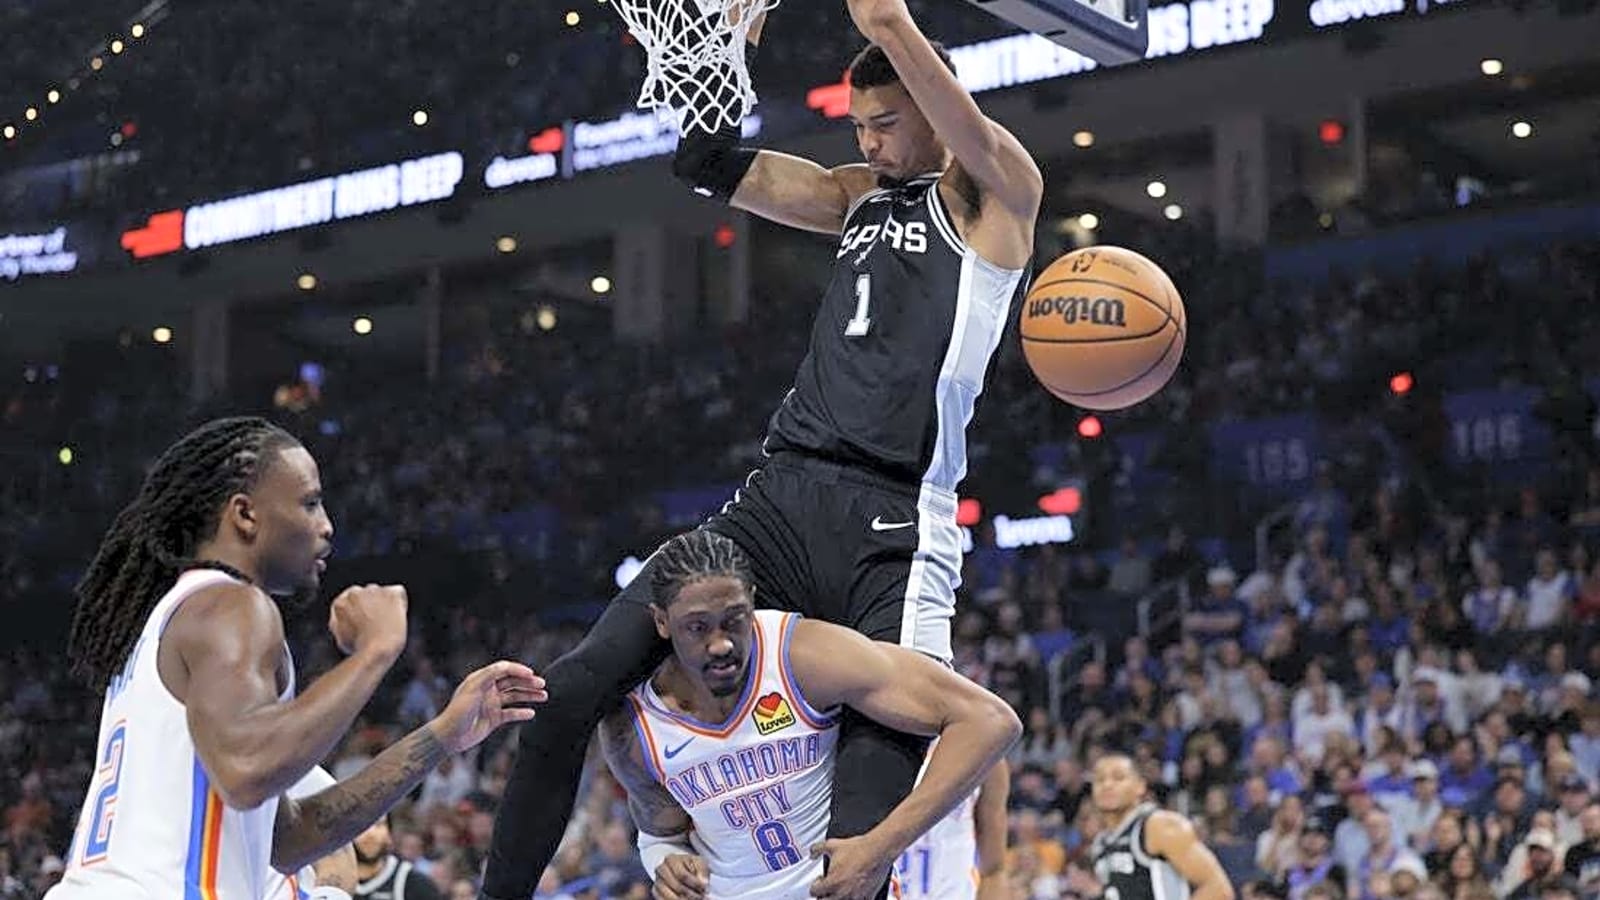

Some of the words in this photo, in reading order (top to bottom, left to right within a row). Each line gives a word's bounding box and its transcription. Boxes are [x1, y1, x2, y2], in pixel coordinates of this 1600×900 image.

[1190, 0, 1274, 49] DEEP
[184, 177, 333, 249] COMMITMENT
[335, 163, 398, 219] RUNS
[400, 151, 463, 206] DEEP
[844, 274, 871, 337] 1
[1029, 295, 1127, 327] Wilson
[665, 733, 821, 808] OKLAHOMA
[720, 781, 793, 831] CITY
[751, 817, 803, 872] 8
